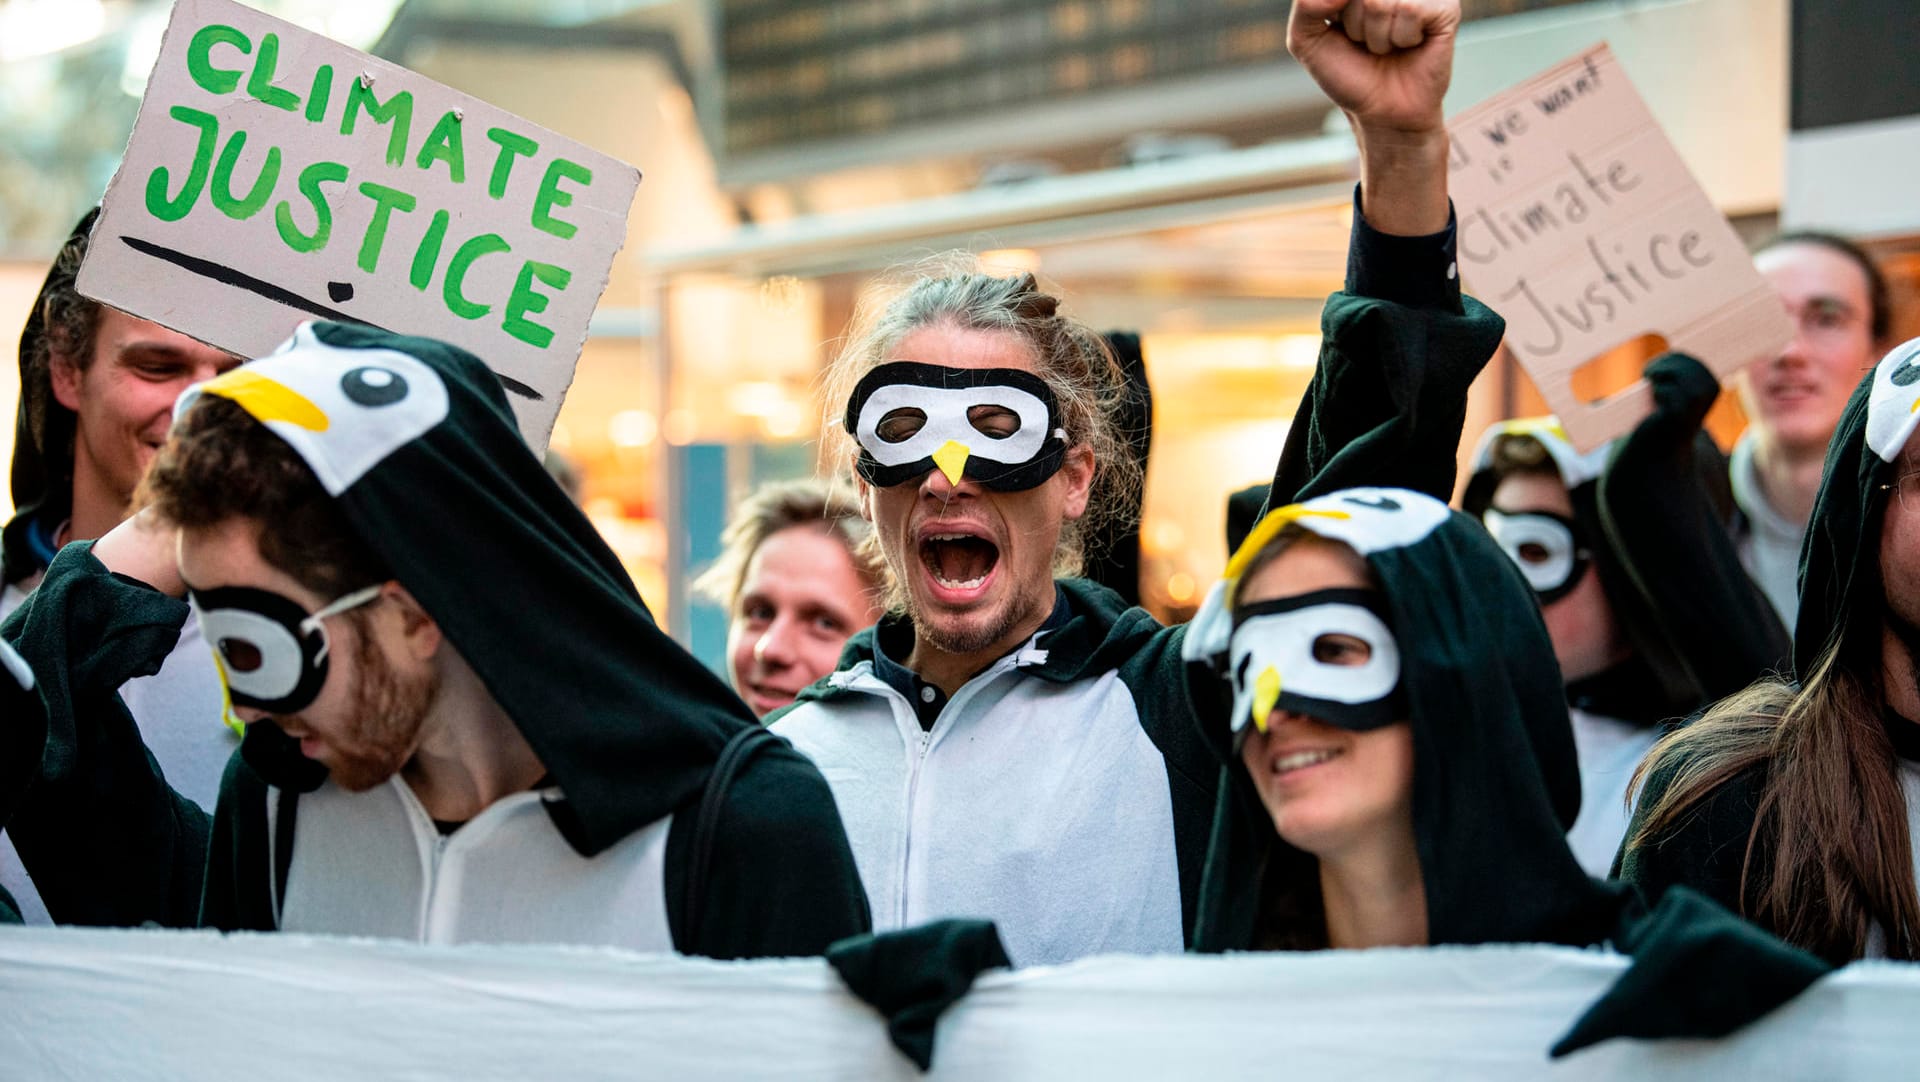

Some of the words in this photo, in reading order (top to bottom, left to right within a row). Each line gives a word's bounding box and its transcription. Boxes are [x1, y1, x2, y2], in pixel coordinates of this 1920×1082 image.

[187, 24, 593, 239] CLIMATE
[1483, 110, 1527, 145] we
[1536, 55, 1601, 115] want
[145, 105, 572, 349] JUSTICE
[1457, 151, 1644, 265] Climate
[1502, 227, 1715, 358] Justice
